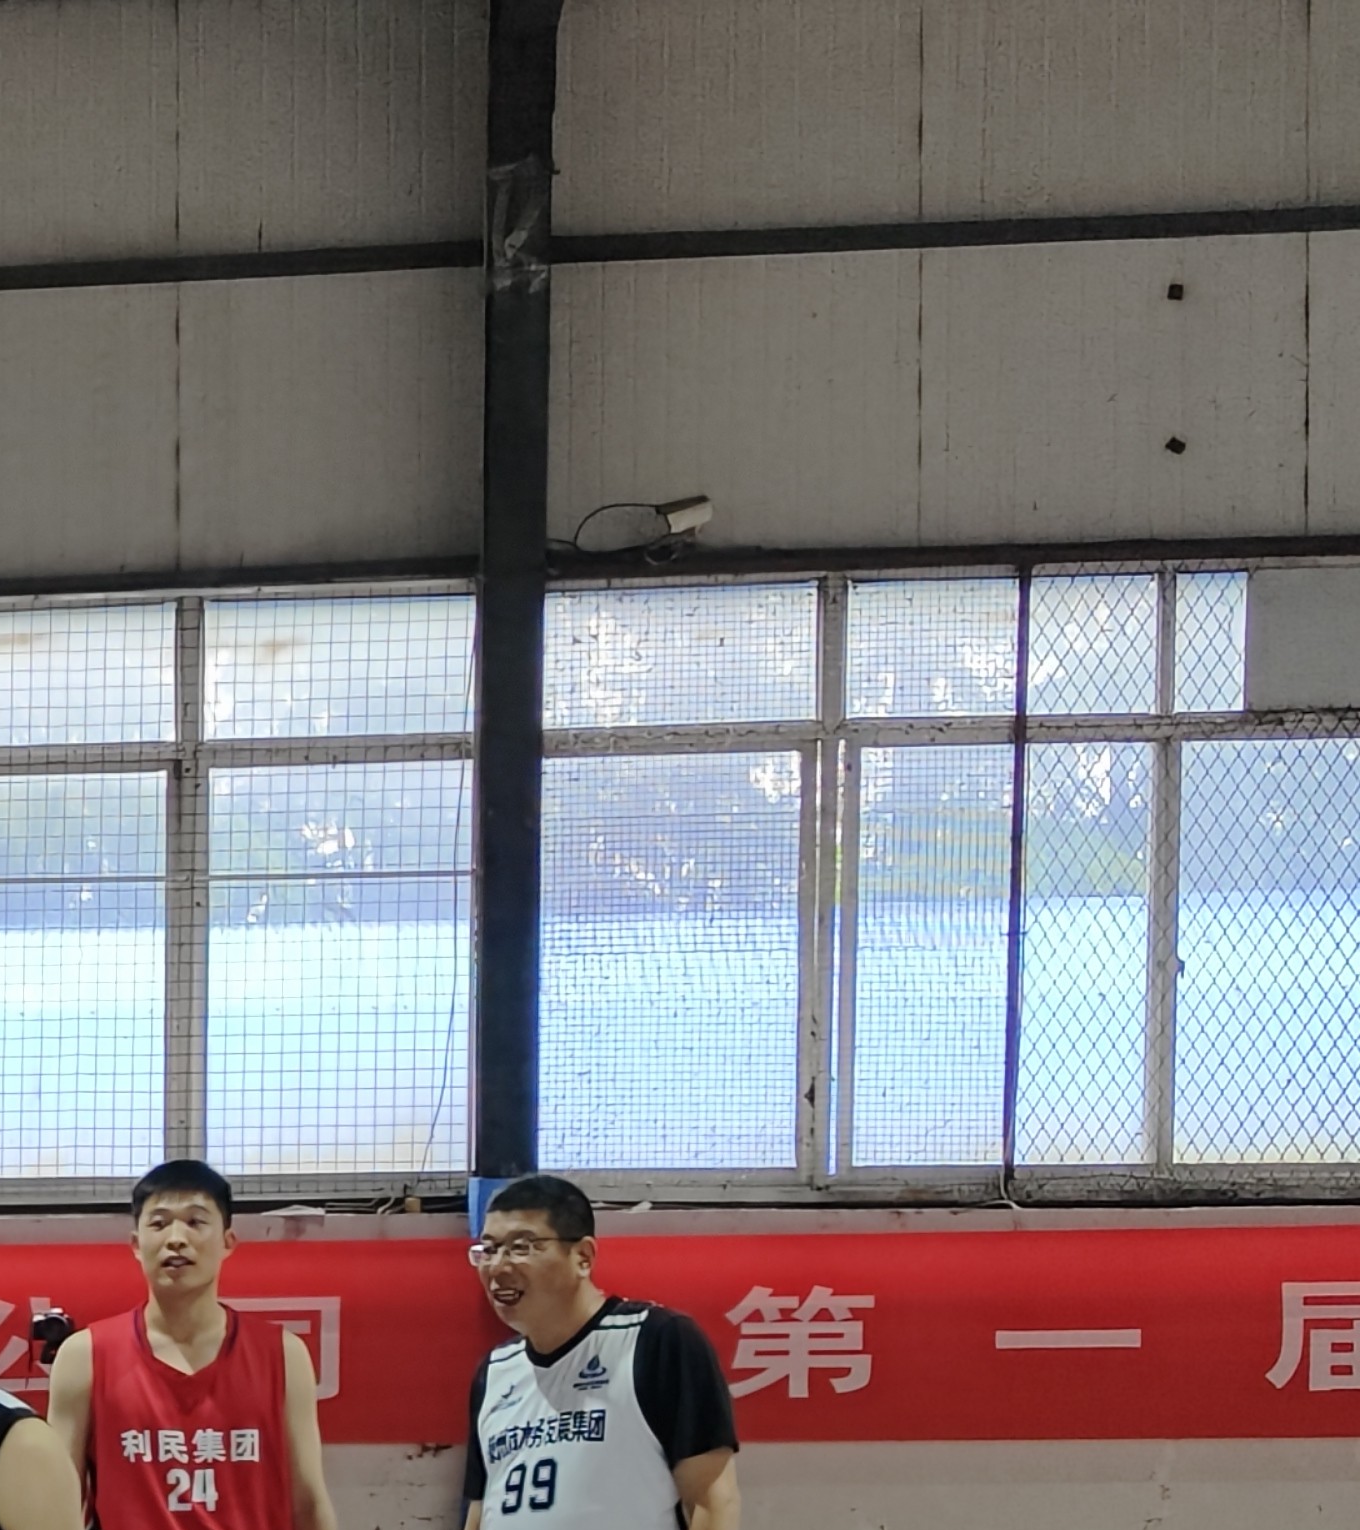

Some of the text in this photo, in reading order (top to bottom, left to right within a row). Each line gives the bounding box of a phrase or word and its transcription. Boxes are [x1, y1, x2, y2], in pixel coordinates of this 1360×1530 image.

[120, 1428, 260, 1463] 利民集团
[166, 1468, 218, 1512] 24
[501, 1458, 557, 1515] 99
